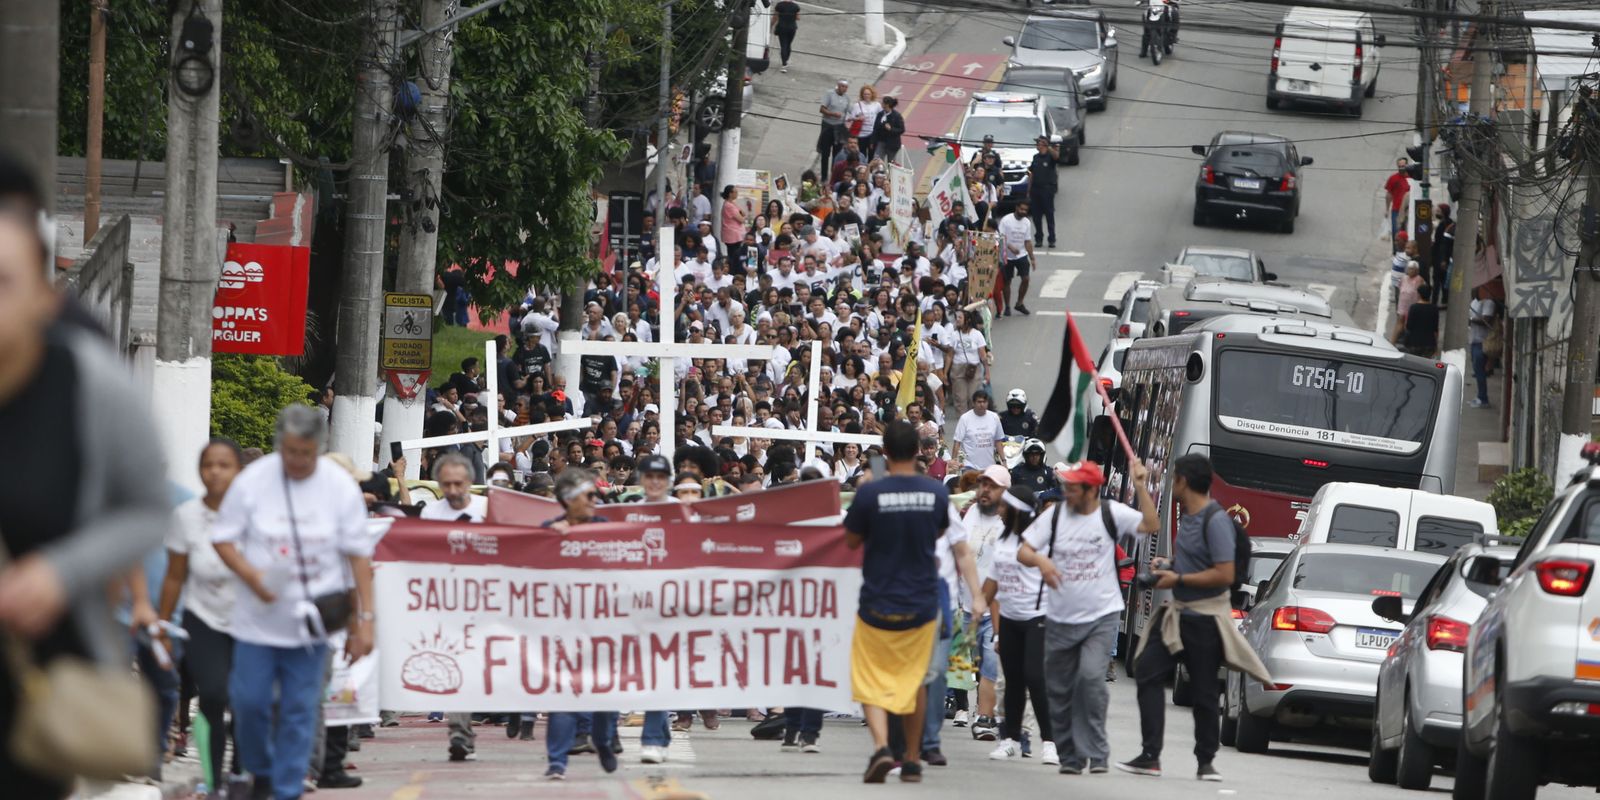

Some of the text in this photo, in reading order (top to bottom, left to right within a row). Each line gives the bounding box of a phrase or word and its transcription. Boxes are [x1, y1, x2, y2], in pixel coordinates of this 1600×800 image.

[392, 297, 425, 305] CICLISTA
[212, 330, 261, 342] RGUER
[222, 321, 235, 329] DO
[1293, 365, 1364, 393] 675A-10
[1237, 419, 1266, 431] Disque
[1269, 423, 1309, 437] Denúncia
[1316, 430, 1336, 442] 181
[407, 567, 838, 620] SAÚDE MENTAL NA QUEBRADA
[483, 628, 837, 698] FUNDAMENTAL
